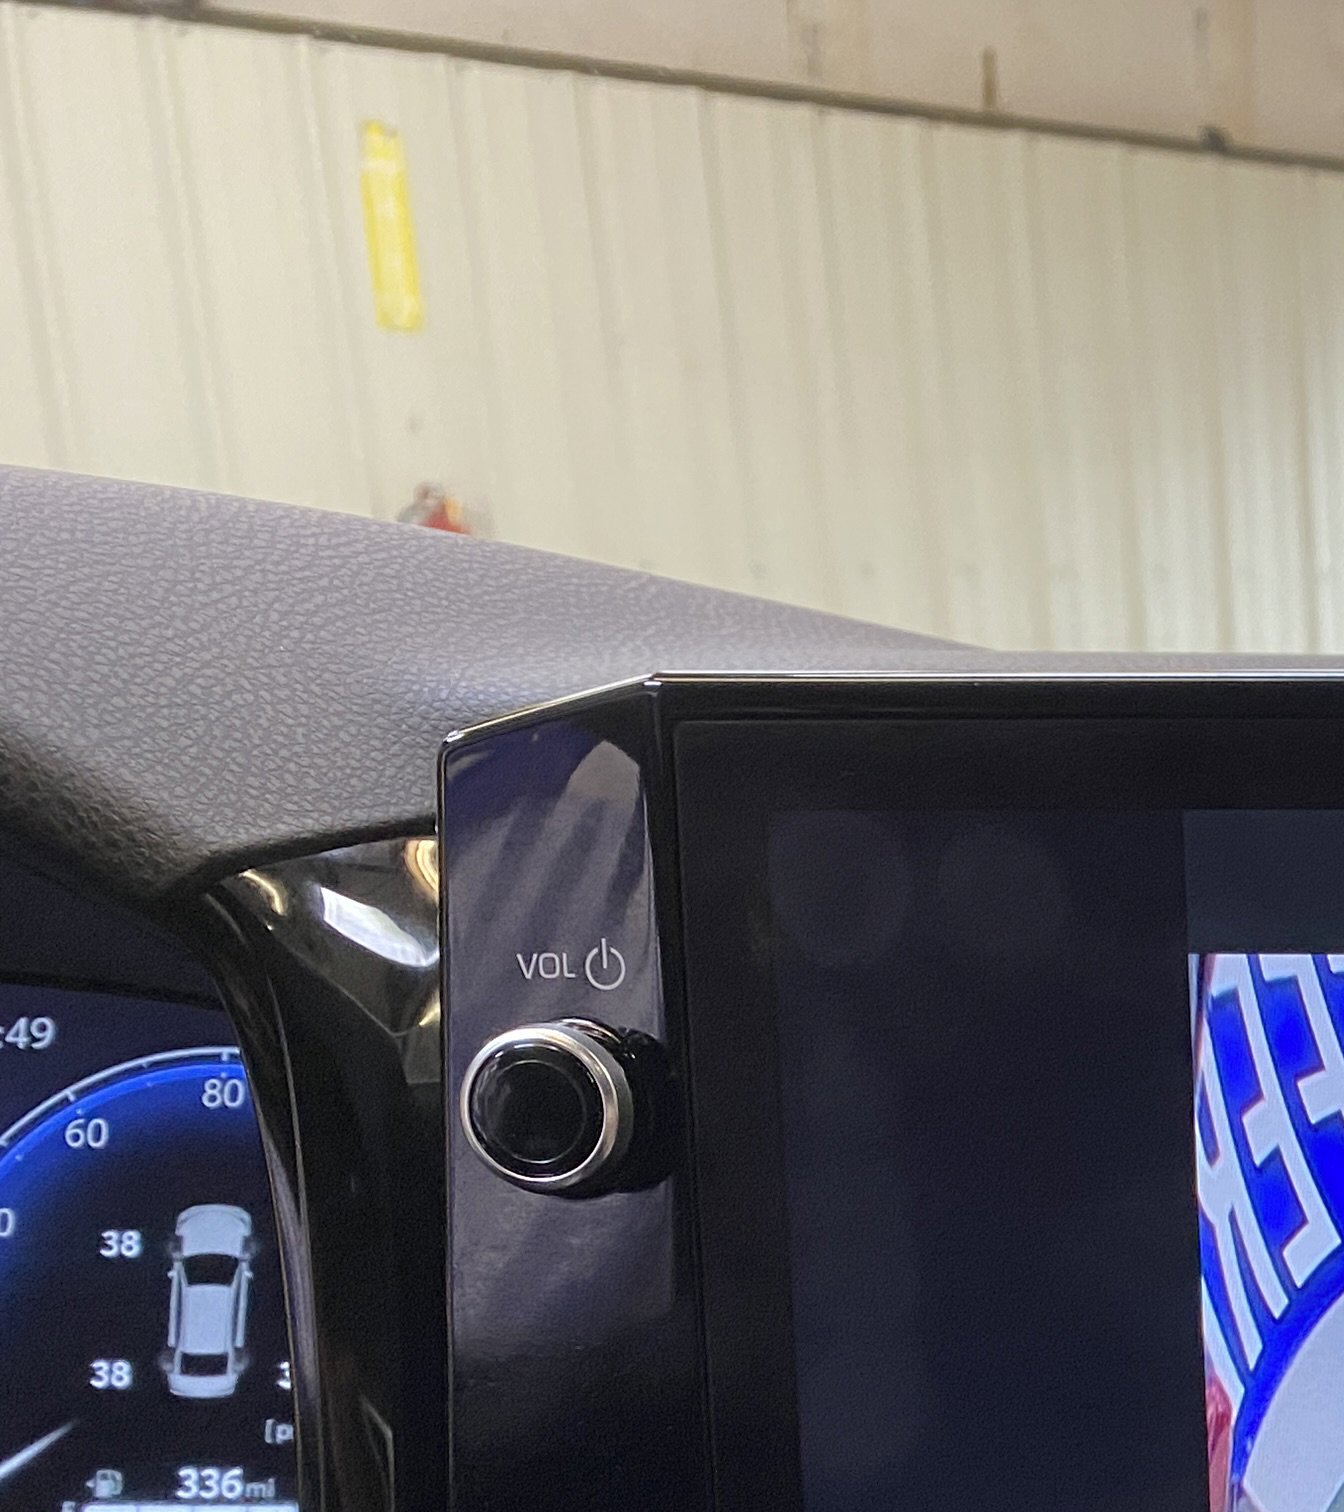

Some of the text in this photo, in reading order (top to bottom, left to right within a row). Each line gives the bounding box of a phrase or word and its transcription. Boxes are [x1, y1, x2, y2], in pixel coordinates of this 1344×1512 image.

[516, 952, 576, 980] VOL
[201, 1078, 246, 1109] 80
[64, 1117, 110, 1149] 60
[99, 1228, 143, 1258] 38
[88, 1358, 133, 1390] 38
